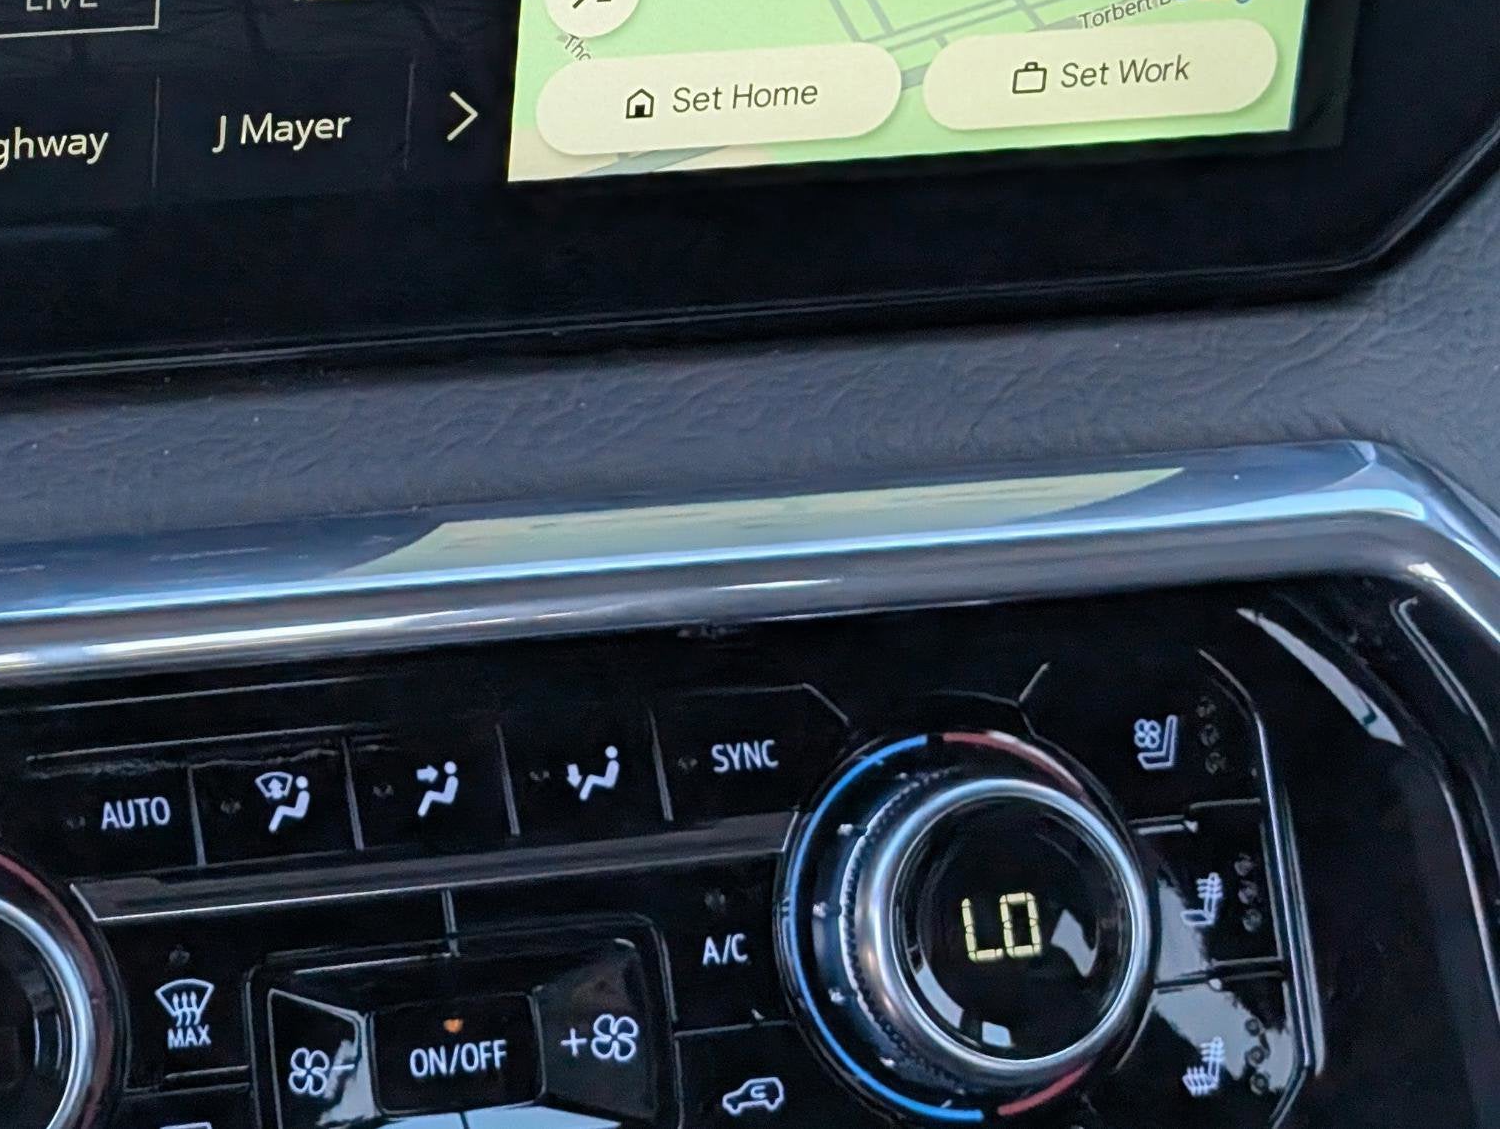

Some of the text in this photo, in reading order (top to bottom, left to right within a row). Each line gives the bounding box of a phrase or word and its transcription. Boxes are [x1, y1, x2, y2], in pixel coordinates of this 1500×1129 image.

[1060, 54, 1191, 89] Set Work
[672, 83, 818, 113] Set Home
[211, 112, 352, 154] J Mayer
[711, 739, 779, 773] SYNC
[101, 796, 171, 830] AUTO
[702, 933, 748, 965] A/C
[167, 1024, 212, 1049] MAX
[409, 1039, 507, 1078] ON/OFF
